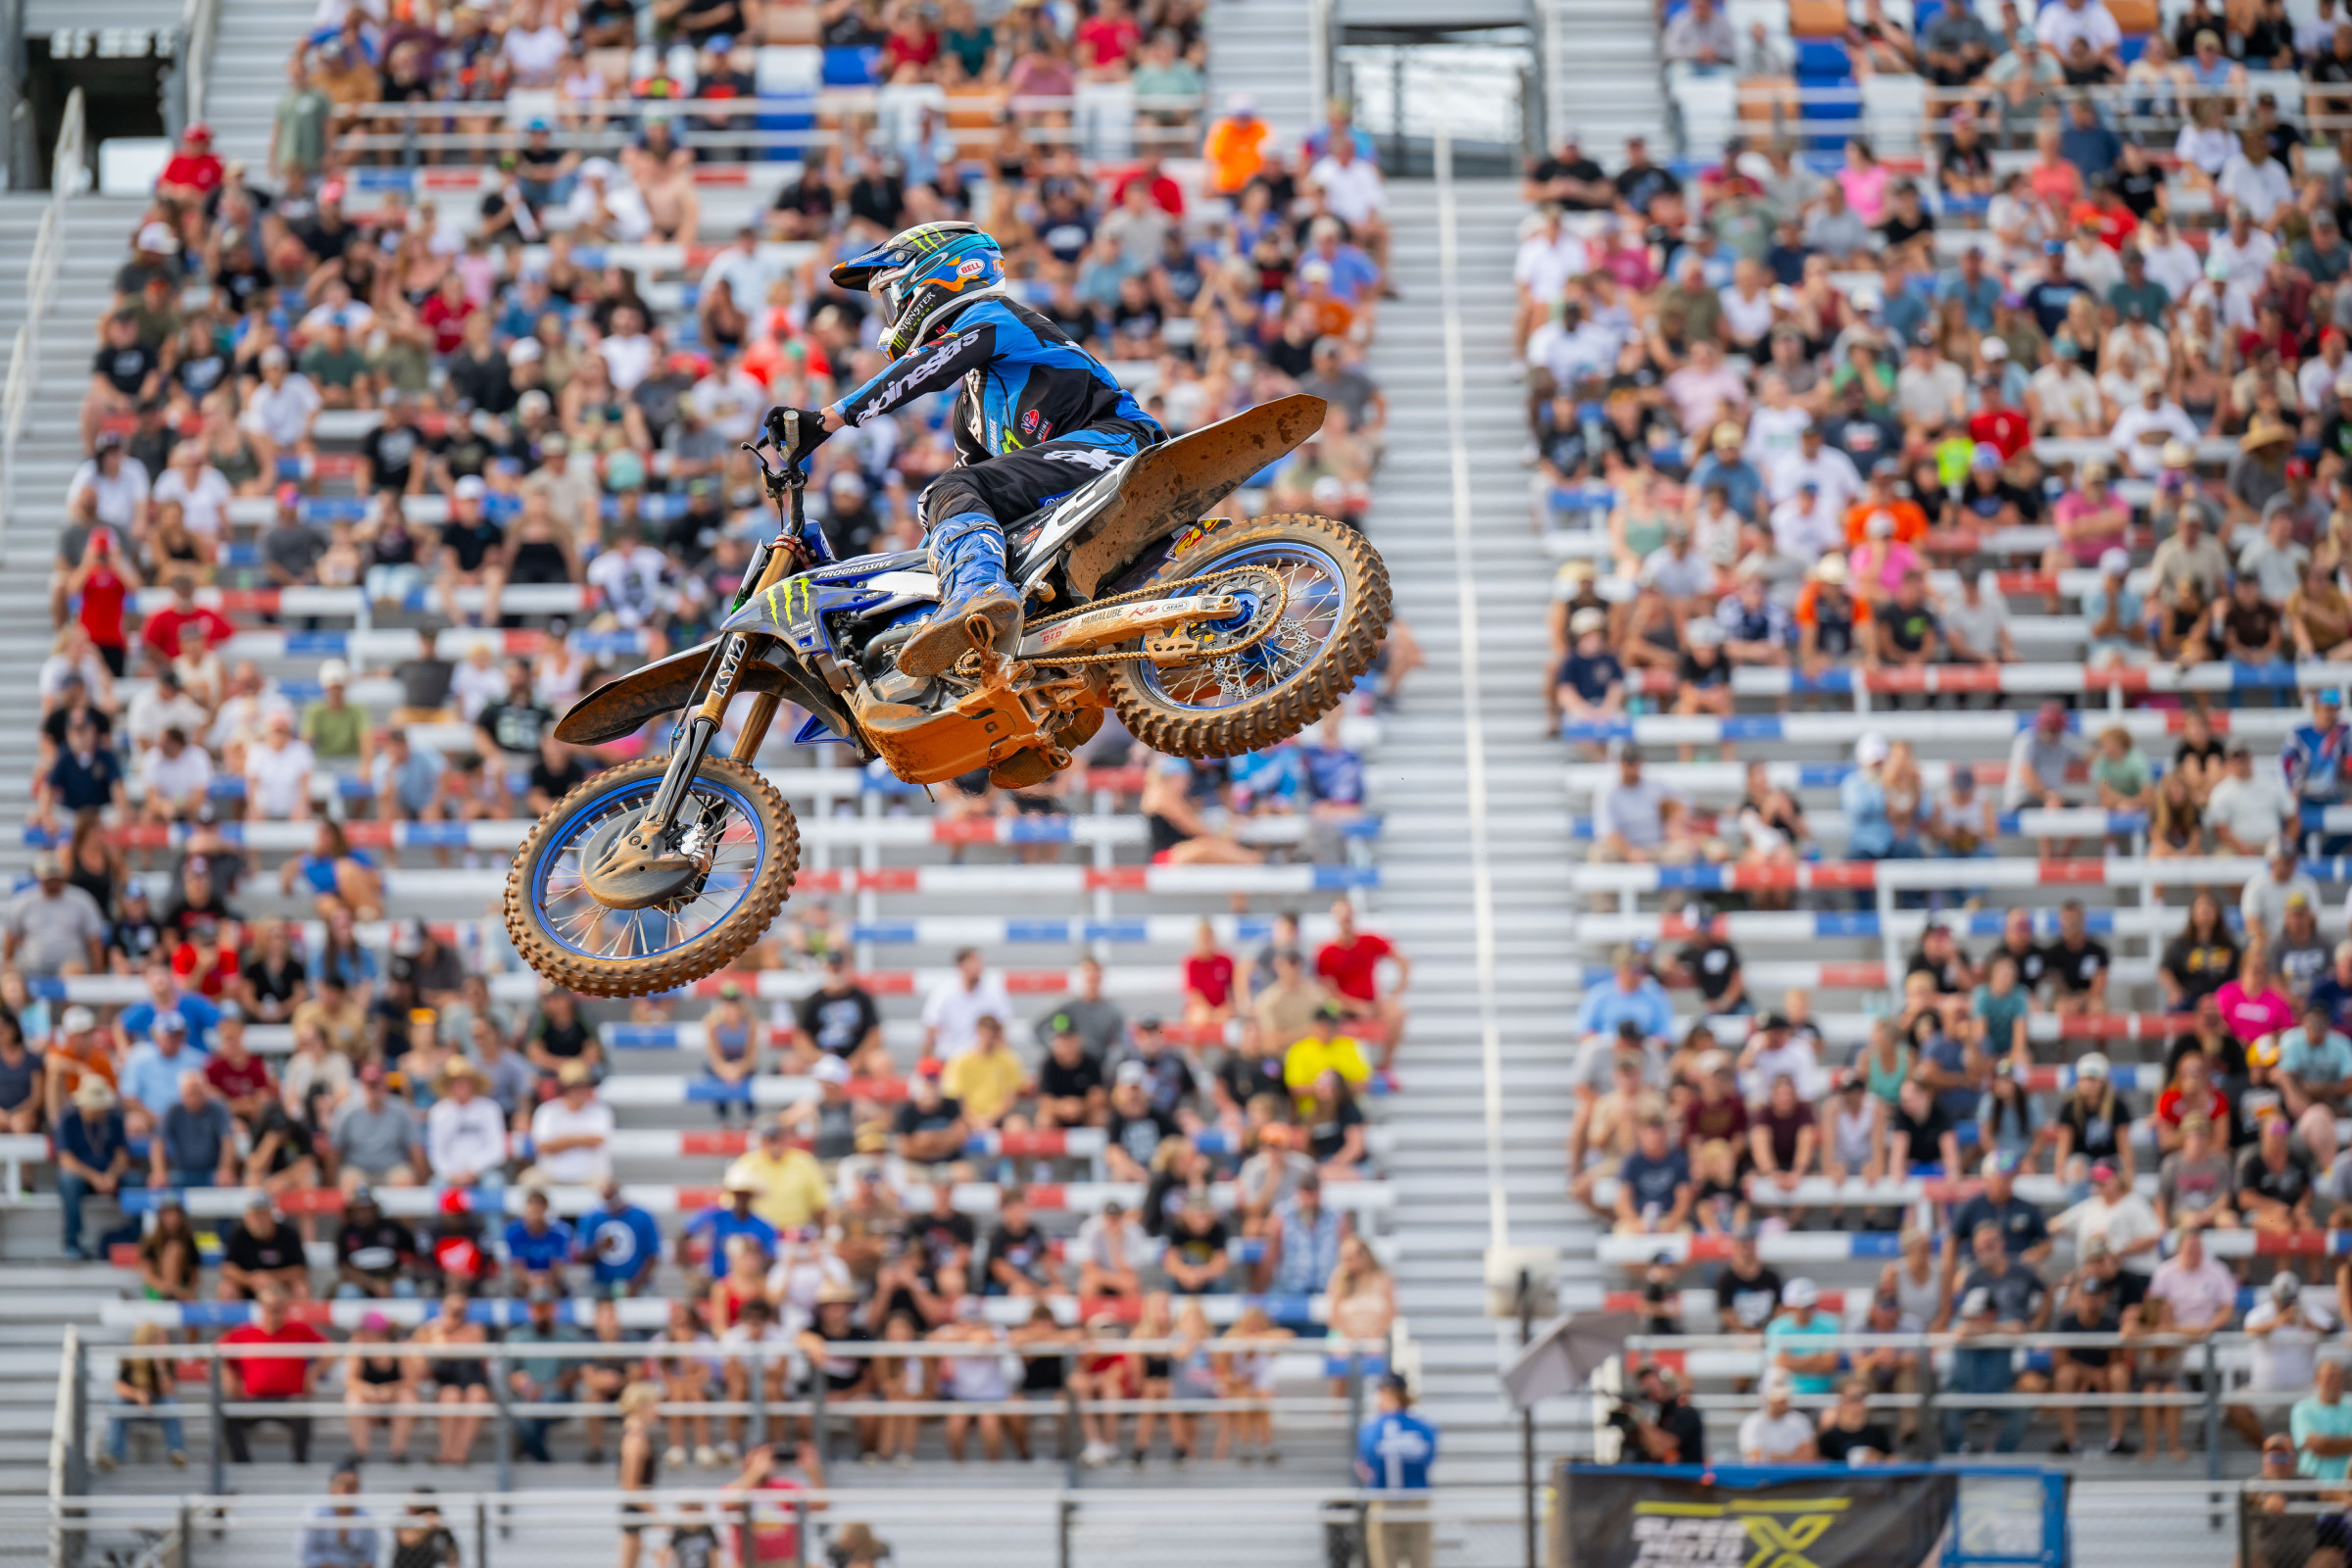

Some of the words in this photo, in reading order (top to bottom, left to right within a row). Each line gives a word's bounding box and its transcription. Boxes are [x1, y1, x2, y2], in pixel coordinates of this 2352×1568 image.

[960, 262, 982, 274] BELL
[899, 291, 936, 333] MONSTER
[908, 303, 934, 331] ENERGY
[856, 328, 981, 426] alpinestars
[1021, 413, 1036, 432] VP
[816, 560, 895, 579] PROGRESSIVE
[1080, 608, 1124, 626] YAMALUBE
[709, 636, 747, 698] KYB
[1632, 1516, 1748, 1542] SUPER
[1638, 1540, 1743, 1560] MOTO
